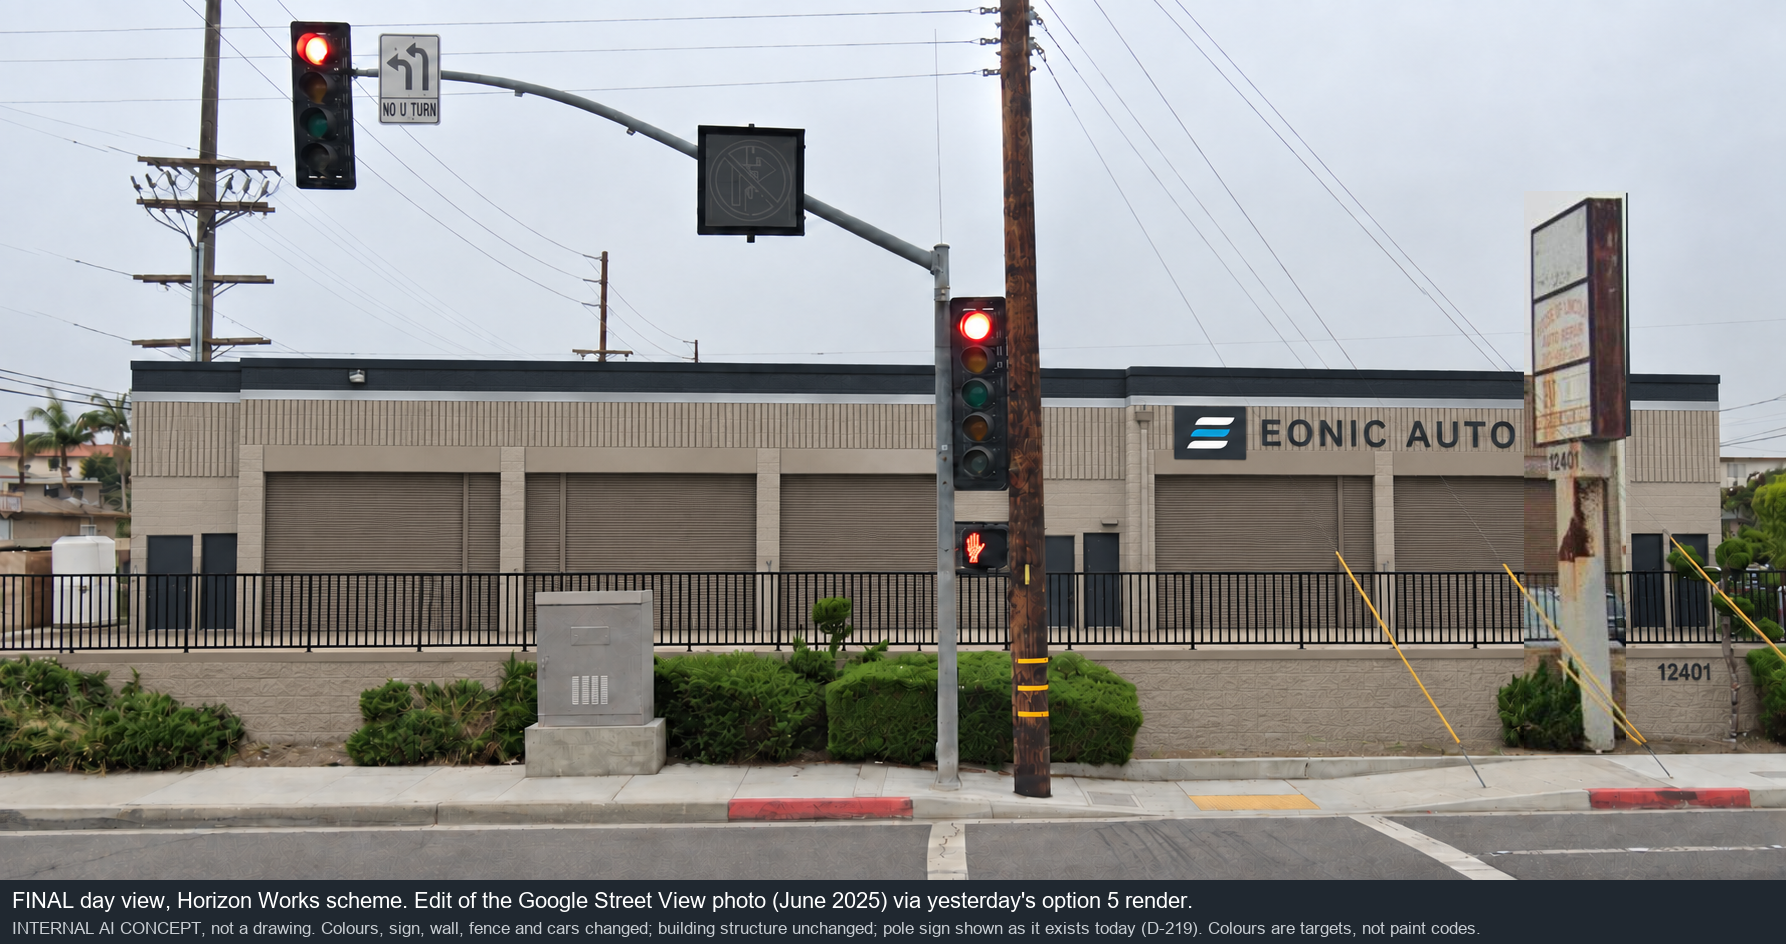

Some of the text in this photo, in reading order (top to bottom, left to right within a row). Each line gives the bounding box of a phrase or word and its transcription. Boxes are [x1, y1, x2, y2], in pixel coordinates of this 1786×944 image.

[383, 102, 437, 117] NO U TURN
[1261, 419, 1516, 449] EONIC AUTO
[1549, 449, 1579, 472] 12401
[1658, 662, 1711, 681] 12401
